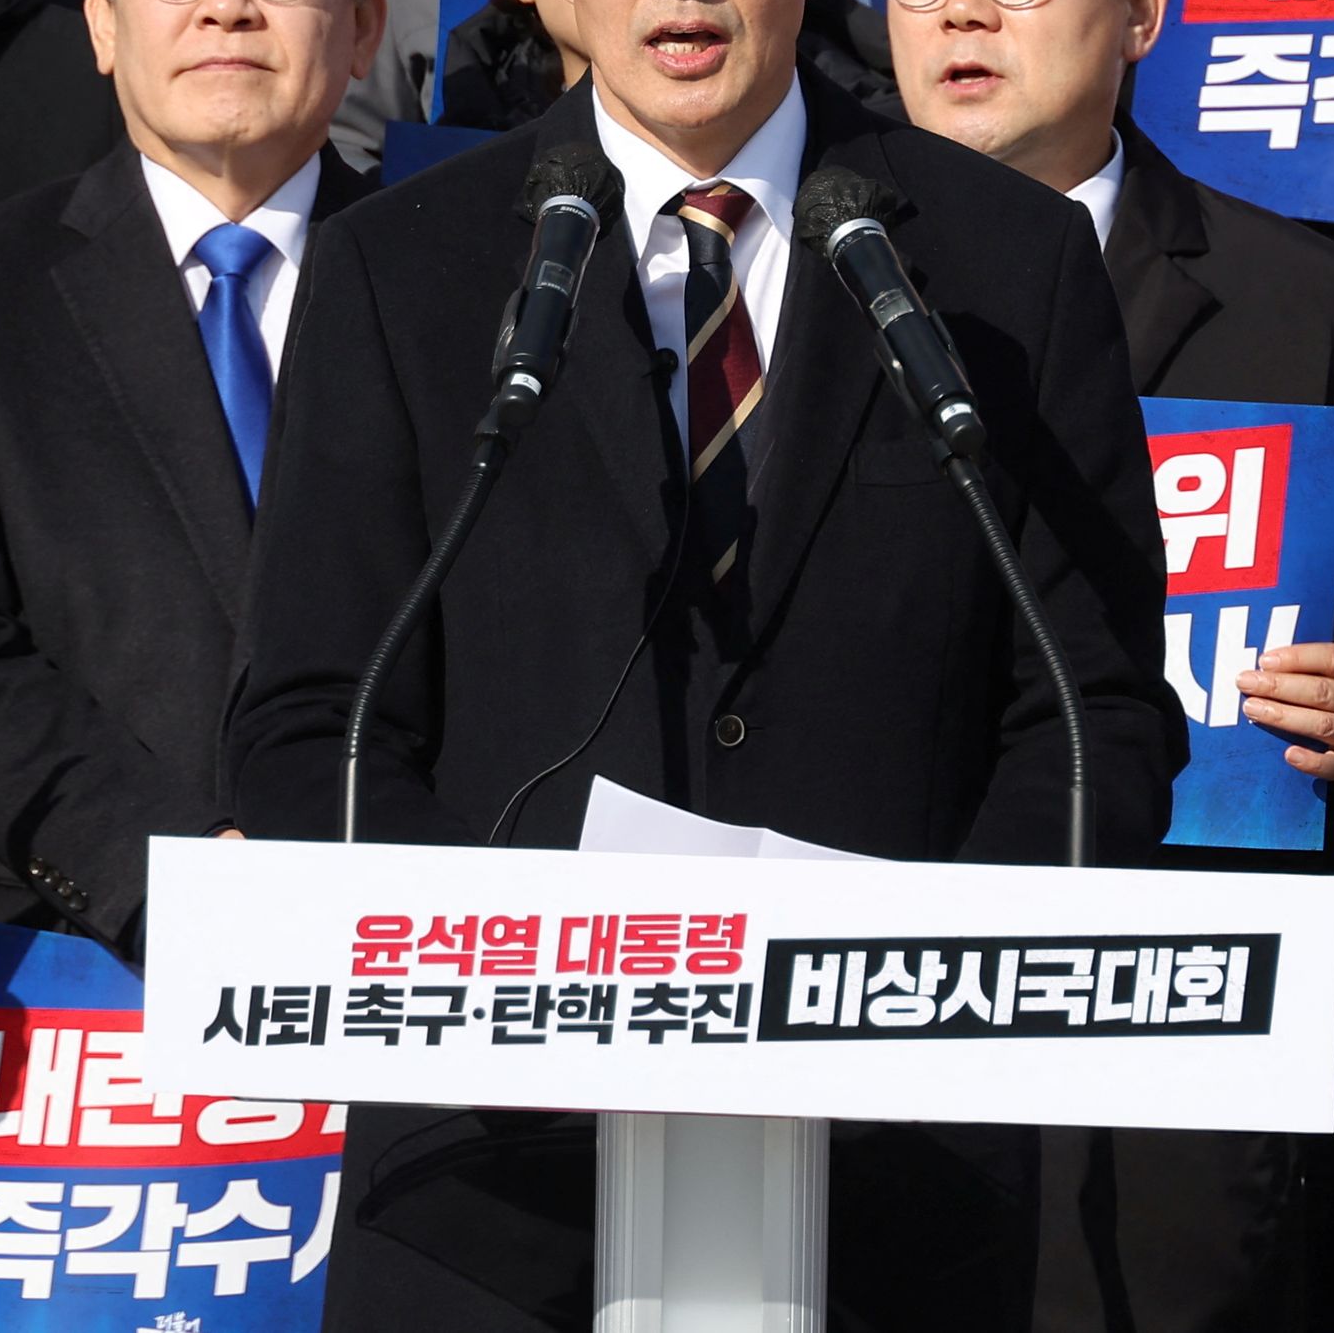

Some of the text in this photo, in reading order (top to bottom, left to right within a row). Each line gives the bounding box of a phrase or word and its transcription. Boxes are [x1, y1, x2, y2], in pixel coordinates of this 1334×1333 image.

[350, 912, 748, 977] 윤석열 대통령
[202, 984, 332, 1046] 사퇴
[627, 981, 753, 1045] 추진
[786, 944, 1250, 1027] 비상시국대회
